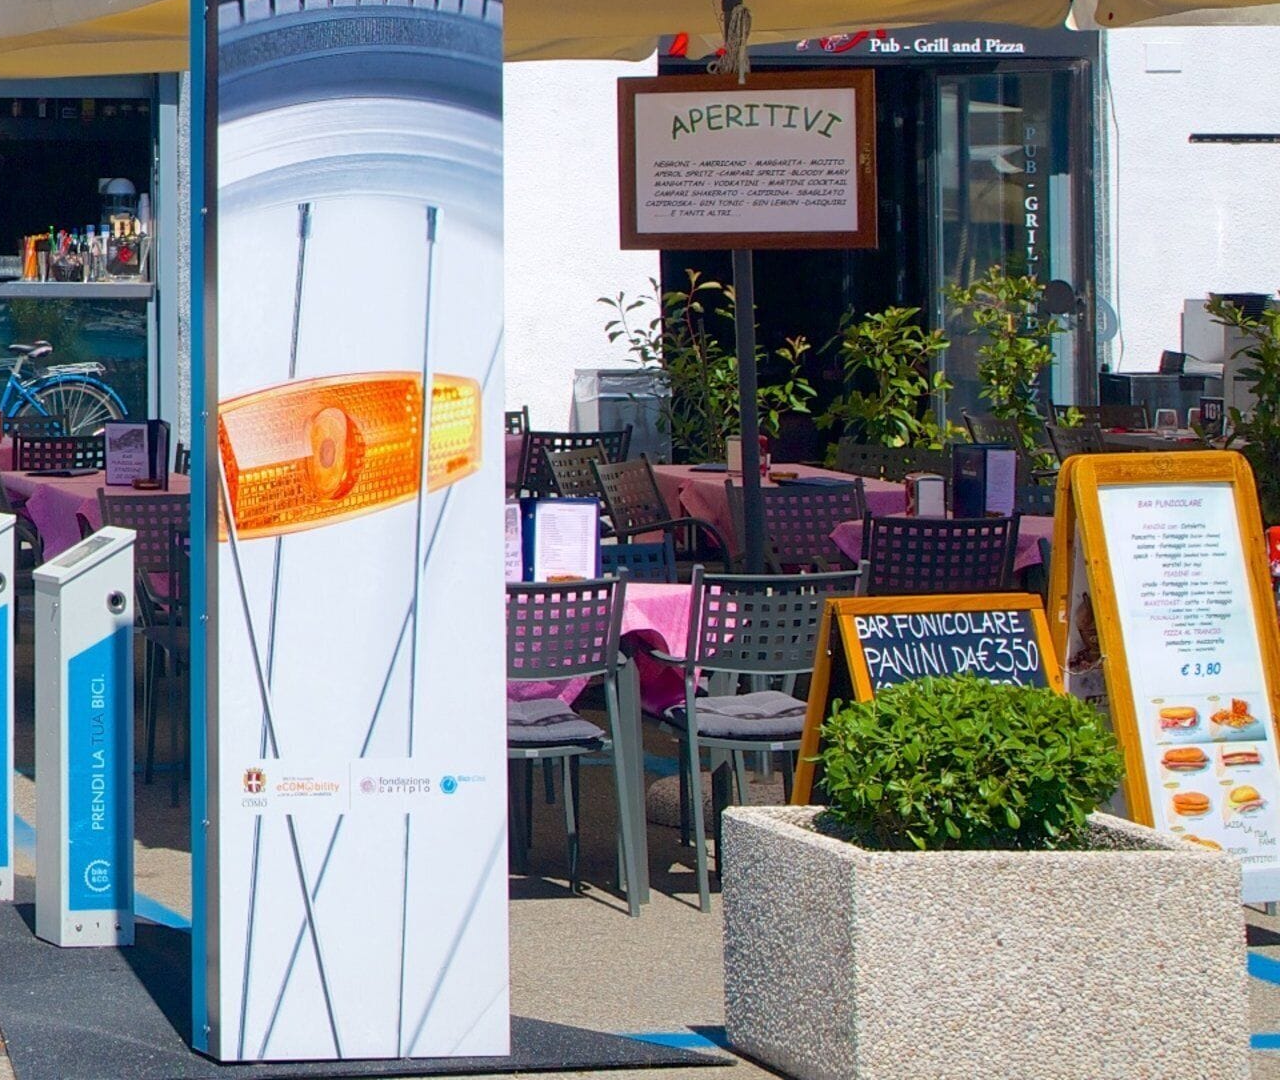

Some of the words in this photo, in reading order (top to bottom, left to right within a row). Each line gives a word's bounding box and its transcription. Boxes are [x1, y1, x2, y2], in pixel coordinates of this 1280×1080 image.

[869, 38, 900, 53] Pub
[914, 38, 949, 53] Grill
[952, 38, 981, 53] and
[985, 39, 1024, 53] Pizza
[672, 103, 842, 140] APERITIVI
[654, 160, 691, 168] NEGRONI
[810, 158, 846, 166] MOJITO
[1025, 127, 1038, 174] PUB
[826, 168, 851, 176] MARY
[1137, 500, 1153, 508] BAR
[1155, 498, 1204, 508] FUNICOLARE
[855, 614, 893, 640] BAR
[895, 611, 1025, 639] FUNICOLARE
[863, 641, 949, 678] PANINI
[1194, 661, 1222, 678] 3,80
[91, 673, 105, 709] BICI.
[91, 712, 105, 746] TUA
[91, 749, 105, 769] LA
[91, 773, 105, 830] PRENDI
